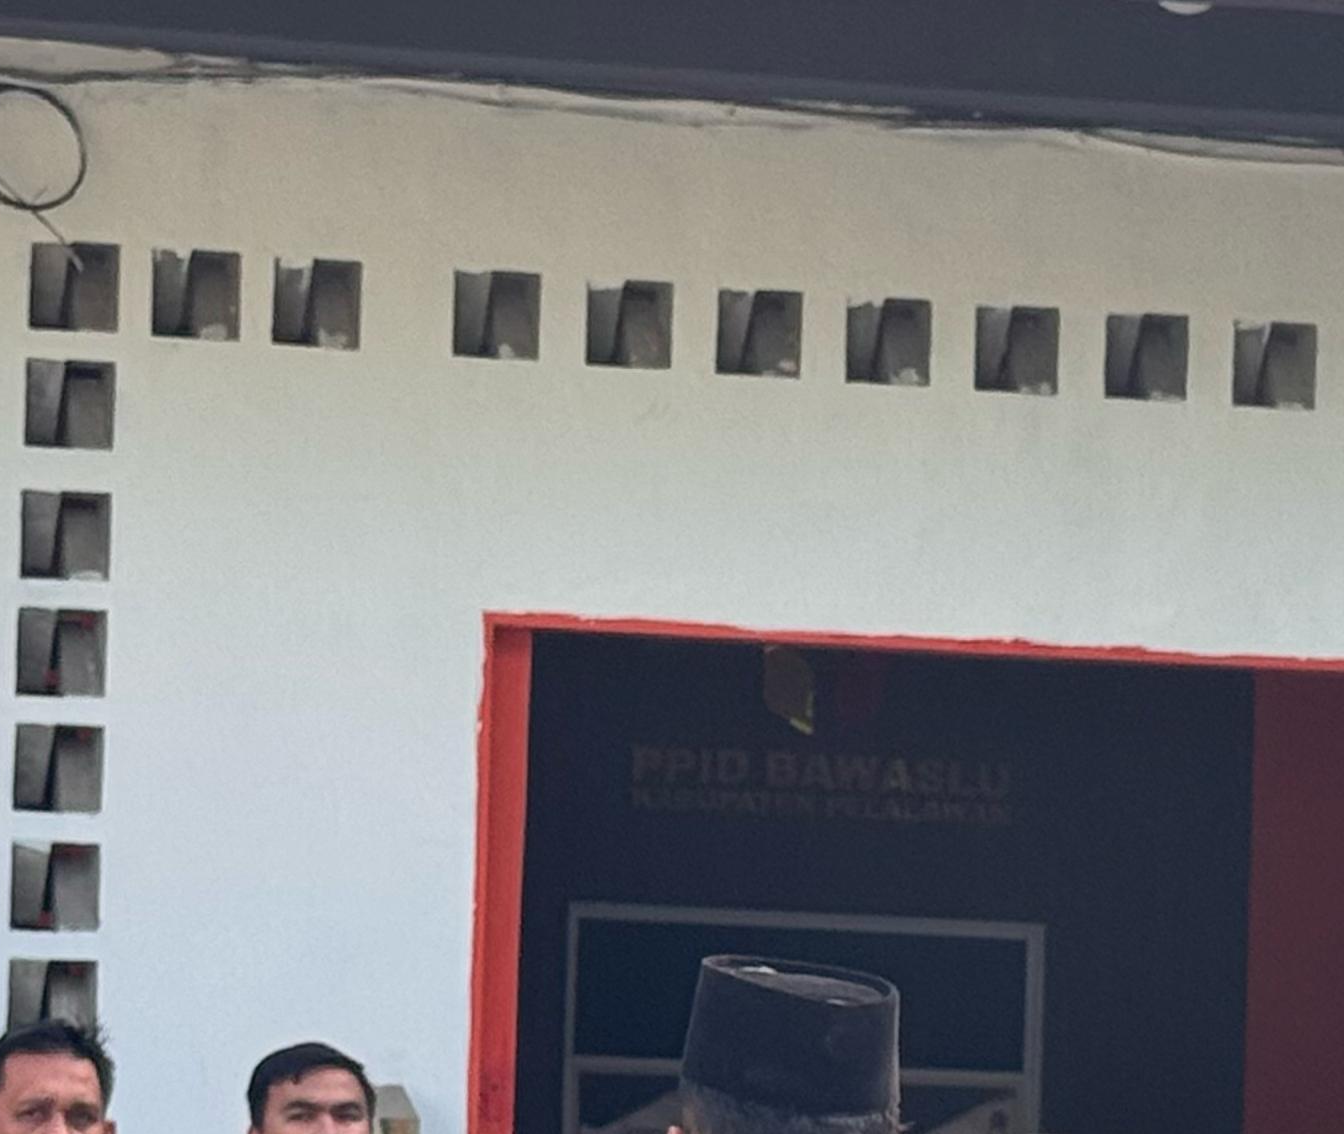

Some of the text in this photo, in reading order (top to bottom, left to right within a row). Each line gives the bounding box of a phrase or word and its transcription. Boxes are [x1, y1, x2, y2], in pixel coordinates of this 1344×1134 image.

[632, 746, 1011, 797] PPID BAWASLU
[632, 788, 1012, 825] KABUPATEN PELALAWAN
